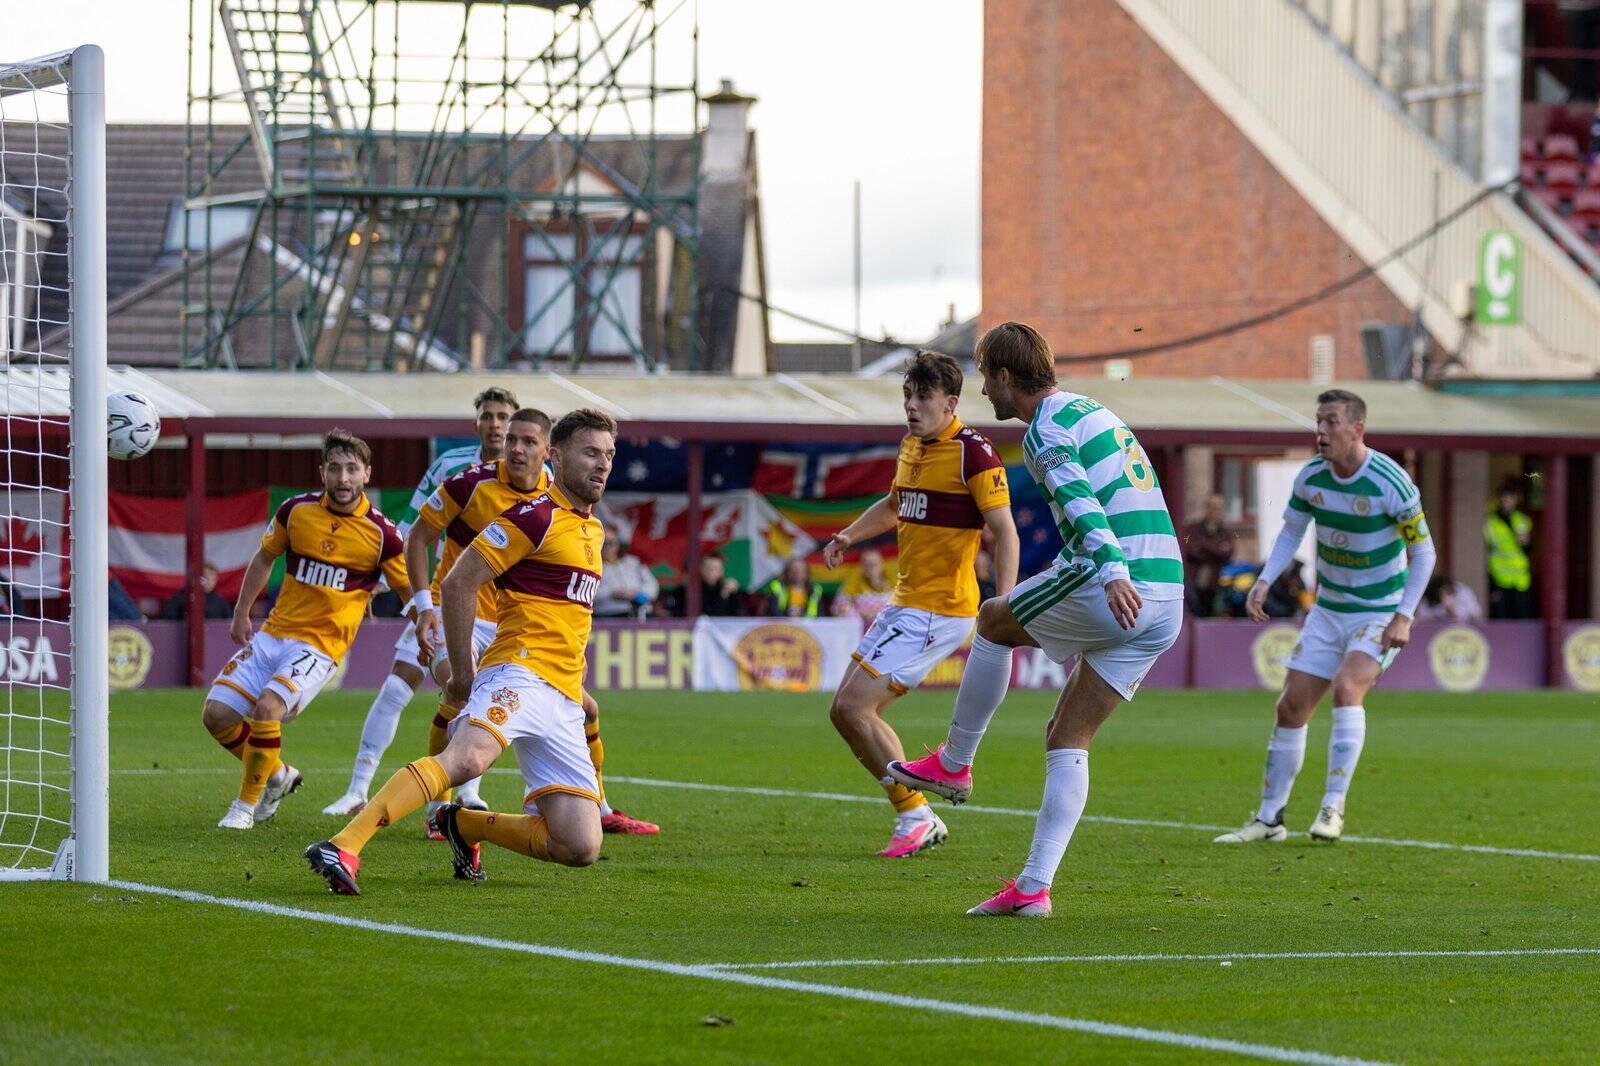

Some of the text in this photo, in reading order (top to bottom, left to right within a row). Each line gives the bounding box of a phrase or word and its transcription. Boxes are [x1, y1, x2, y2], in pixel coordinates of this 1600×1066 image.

[1114, 428, 1154, 493] 8
[1403, 525, 1416, 541] C
[295, 558, 348, 591] Lime
[567, 571, 601, 606] Lim
[877, 627, 904, 648] 7
[291, 650, 318, 676] 71
[588, 630, 693, 689] HER
